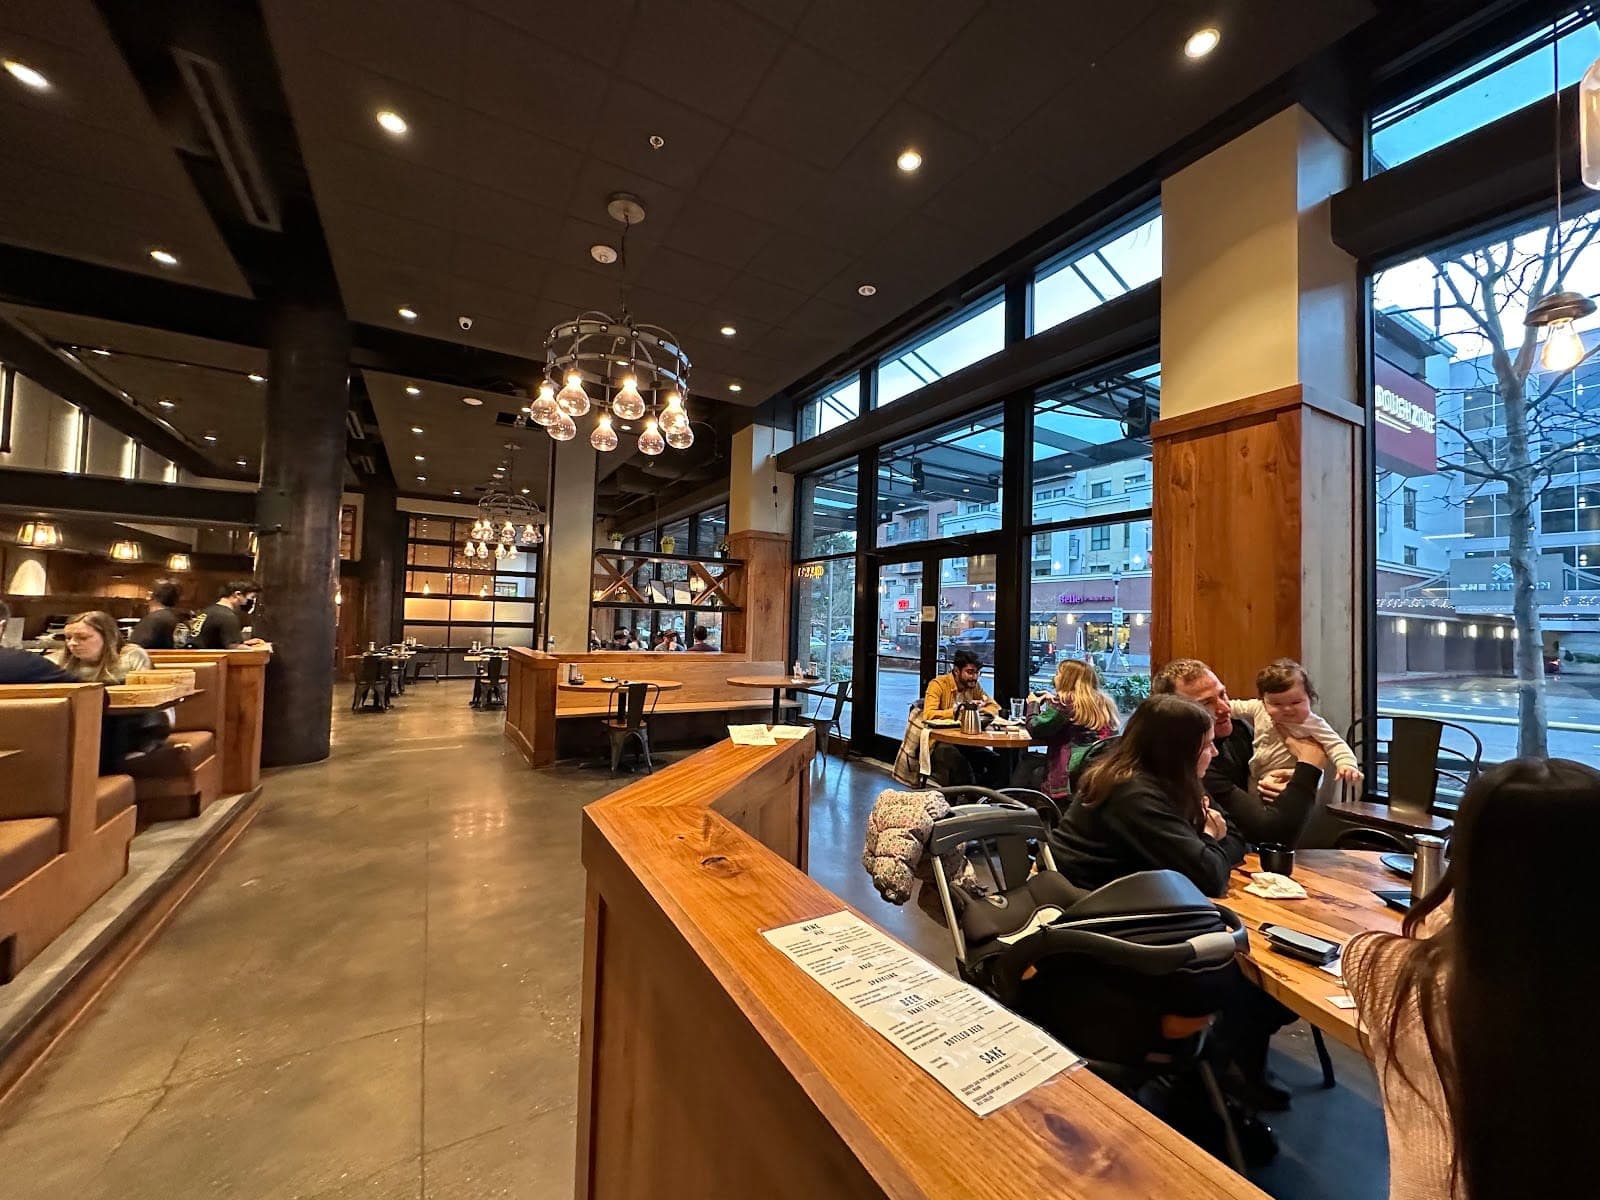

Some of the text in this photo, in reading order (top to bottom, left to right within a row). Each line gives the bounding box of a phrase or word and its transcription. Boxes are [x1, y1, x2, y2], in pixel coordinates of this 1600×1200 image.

[1375, 384, 1435, 434] DOUGH ZONE
[868, 972, 899, 986] SPARKLING
[900, 994, 924, 1007] BEER
[907, 998, 941, 1016] DRAFT BEER
[943, 1030, 971, 1047] BOTTLED
[968, 1024, 985, 1036] BEER
[979, 1046, 1007, 1064] SAKE
